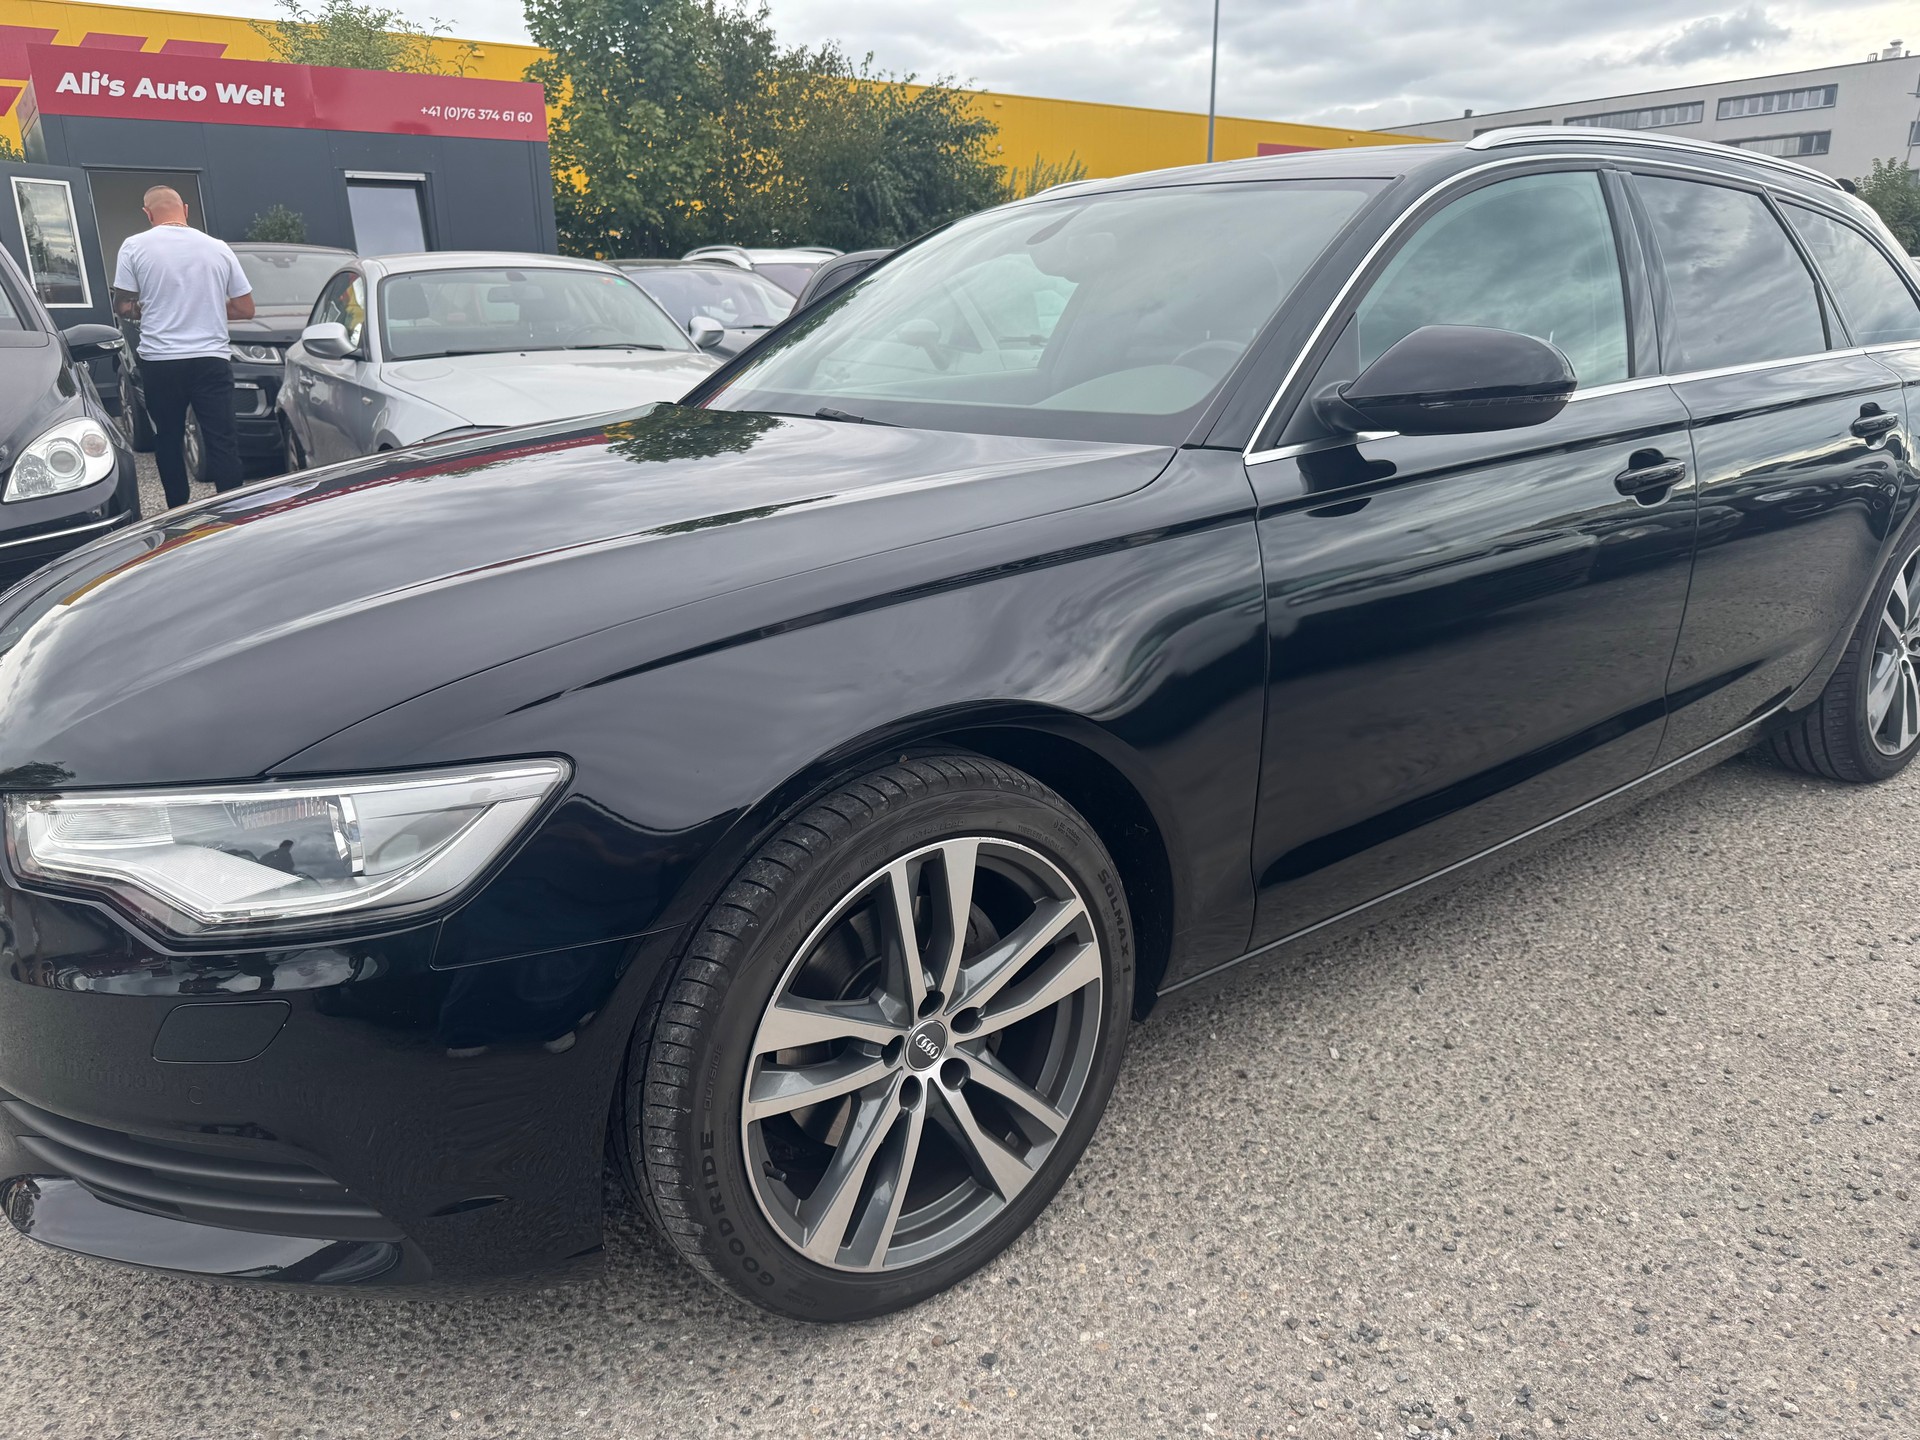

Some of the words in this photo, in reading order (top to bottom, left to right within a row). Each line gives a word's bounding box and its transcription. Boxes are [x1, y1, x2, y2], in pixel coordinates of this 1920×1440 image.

[132, 77, 208, 102] Auto
[215, 82, 286, 107] Welt
[420, 106, 441, 117] +41
[444, 106, 476, 120] (0)76
[477, 109, 500, 121] 374
[502, 111, 515, 122] 61
[517, 111, 533, 123] 60
[1098, 868, 1129, 957] SOLMAX
[701, 1129, 776, 1287] GOODRIDE
